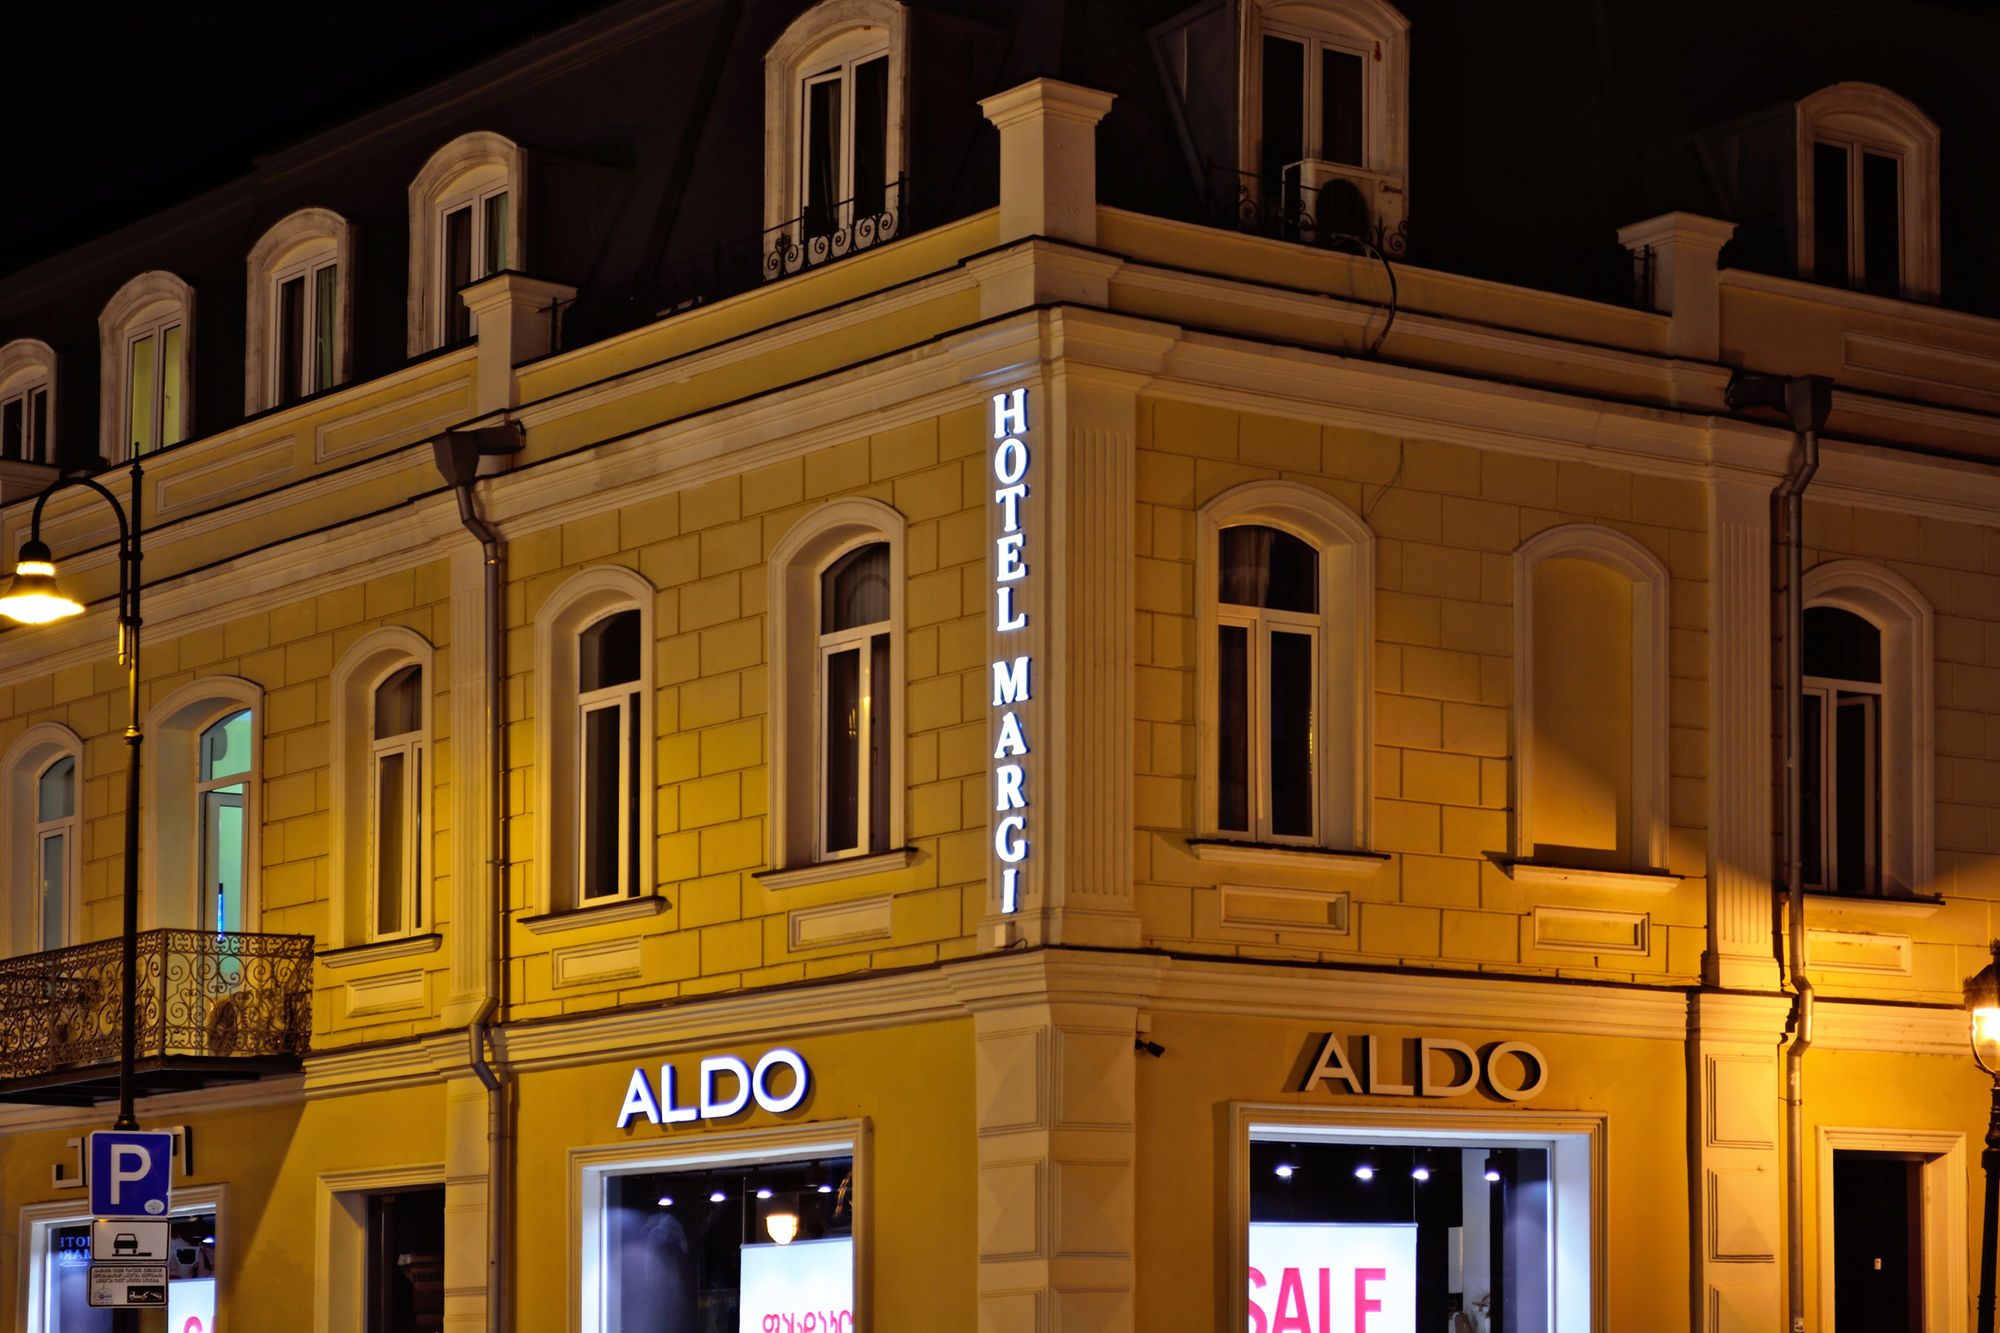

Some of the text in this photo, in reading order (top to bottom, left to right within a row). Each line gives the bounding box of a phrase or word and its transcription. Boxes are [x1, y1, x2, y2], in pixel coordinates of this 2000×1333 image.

[992, 387, 1030, 914] HOTEL MARGI
[616, 1049, 807, 1128] ALDO
[1302, 1032, 1549, 1102] ALDO
[110, 1143, 152, 1205] P
